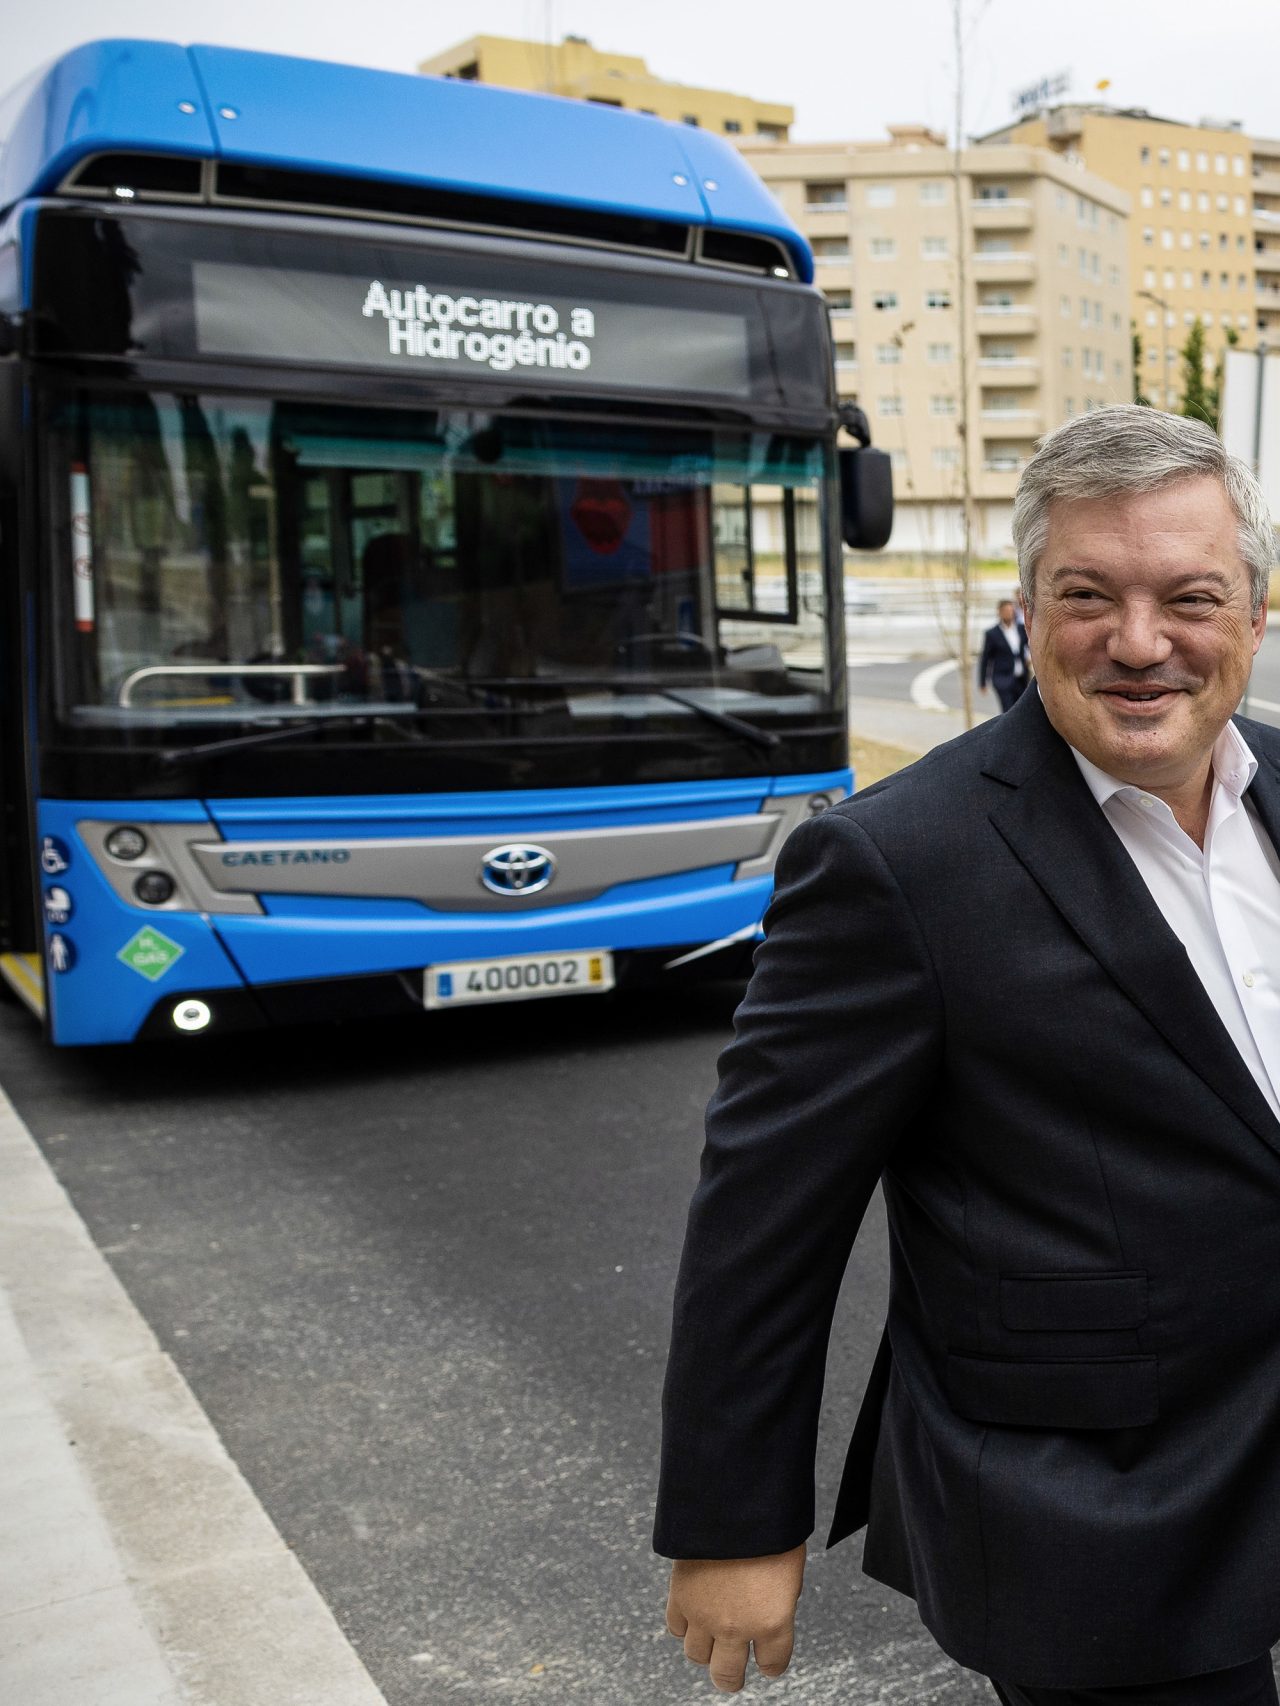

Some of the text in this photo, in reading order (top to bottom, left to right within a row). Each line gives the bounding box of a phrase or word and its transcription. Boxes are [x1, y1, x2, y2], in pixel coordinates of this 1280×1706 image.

[362, 280, 595, 338] Autocarro a
[221, 848, 350, 867] CAETANO
[466, 960, 578, 992] 400002
